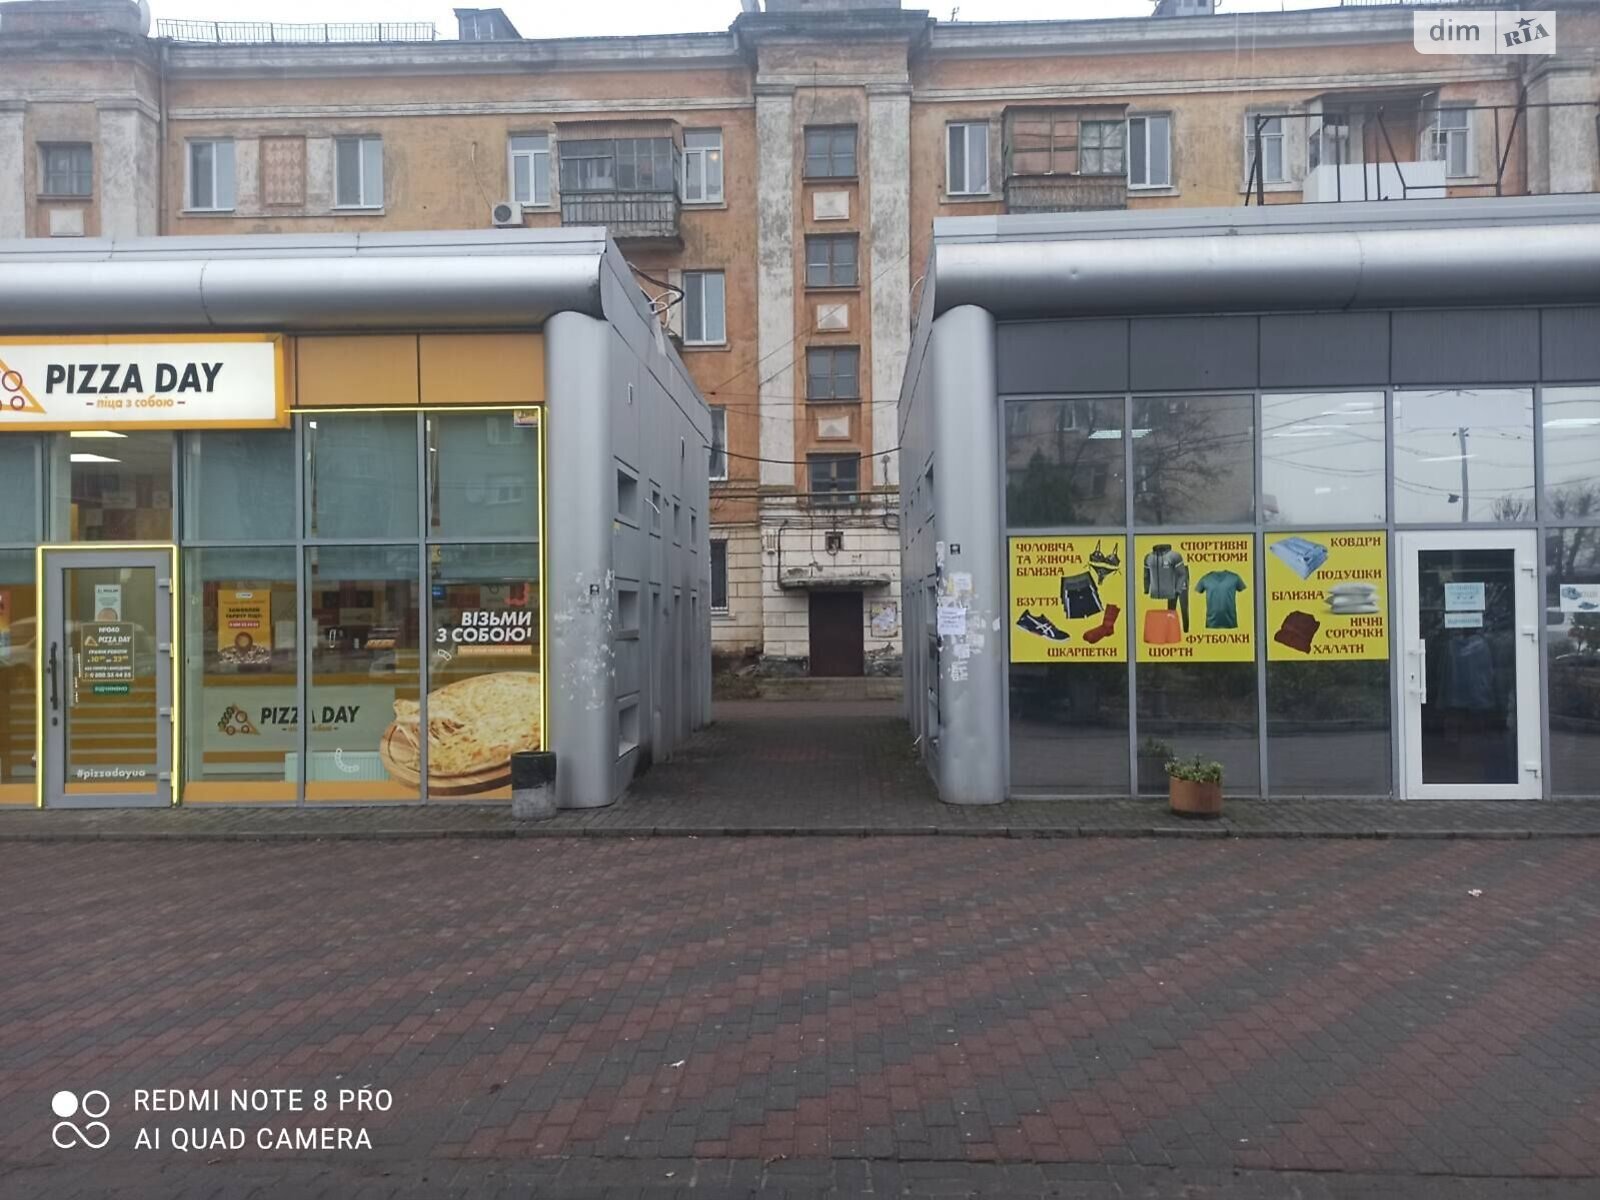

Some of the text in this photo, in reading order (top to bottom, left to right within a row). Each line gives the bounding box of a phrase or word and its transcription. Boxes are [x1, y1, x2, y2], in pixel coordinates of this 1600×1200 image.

[45, 362, 224, 395] PIZZA DAY
[96, 395, 174, 410] піца з собою
[1016, 542, 1074, 552] ЧОЛОВІЧА
[1180, 540, 1248, 551] СПОРТИВНІ
[1330, 537, 1381, 548] КОВДРИ
[1016, 554, 1082, 564] ТА ЖІНОЧА
[1186, 552, 1248, 563] КОСТЮМИ
[1016, 566, 1065, 577] БІЛИЗНА
[1316, 569, 1382, 580] ПОДУШКИ
[1271, 590, 1325, 601] БІЛИЗНА
[1016, 597, 1059, 607] ВЗУТТЯ
[461, 611, 532, 627] ВІЗЬМИ
[1350, 616, 1383, 627] НІЧНІ
[436, 627, 532, 643] З СОБОЮ!
[1325, 627, 1383, 639] СОРОЧКИ
[1185, 633, 1250, 645] ФУТБОЛКИ
[1047, 647, 1117, 657] ШКАРПЕТКИ
[1148, 647, 1194, 657] ШОРТИ
[1313, 643, 1365, 654] ХАЛАТИ
[321, 705, 360, 723] DAY
[77, 767, 146, 781] #pizzadayua
